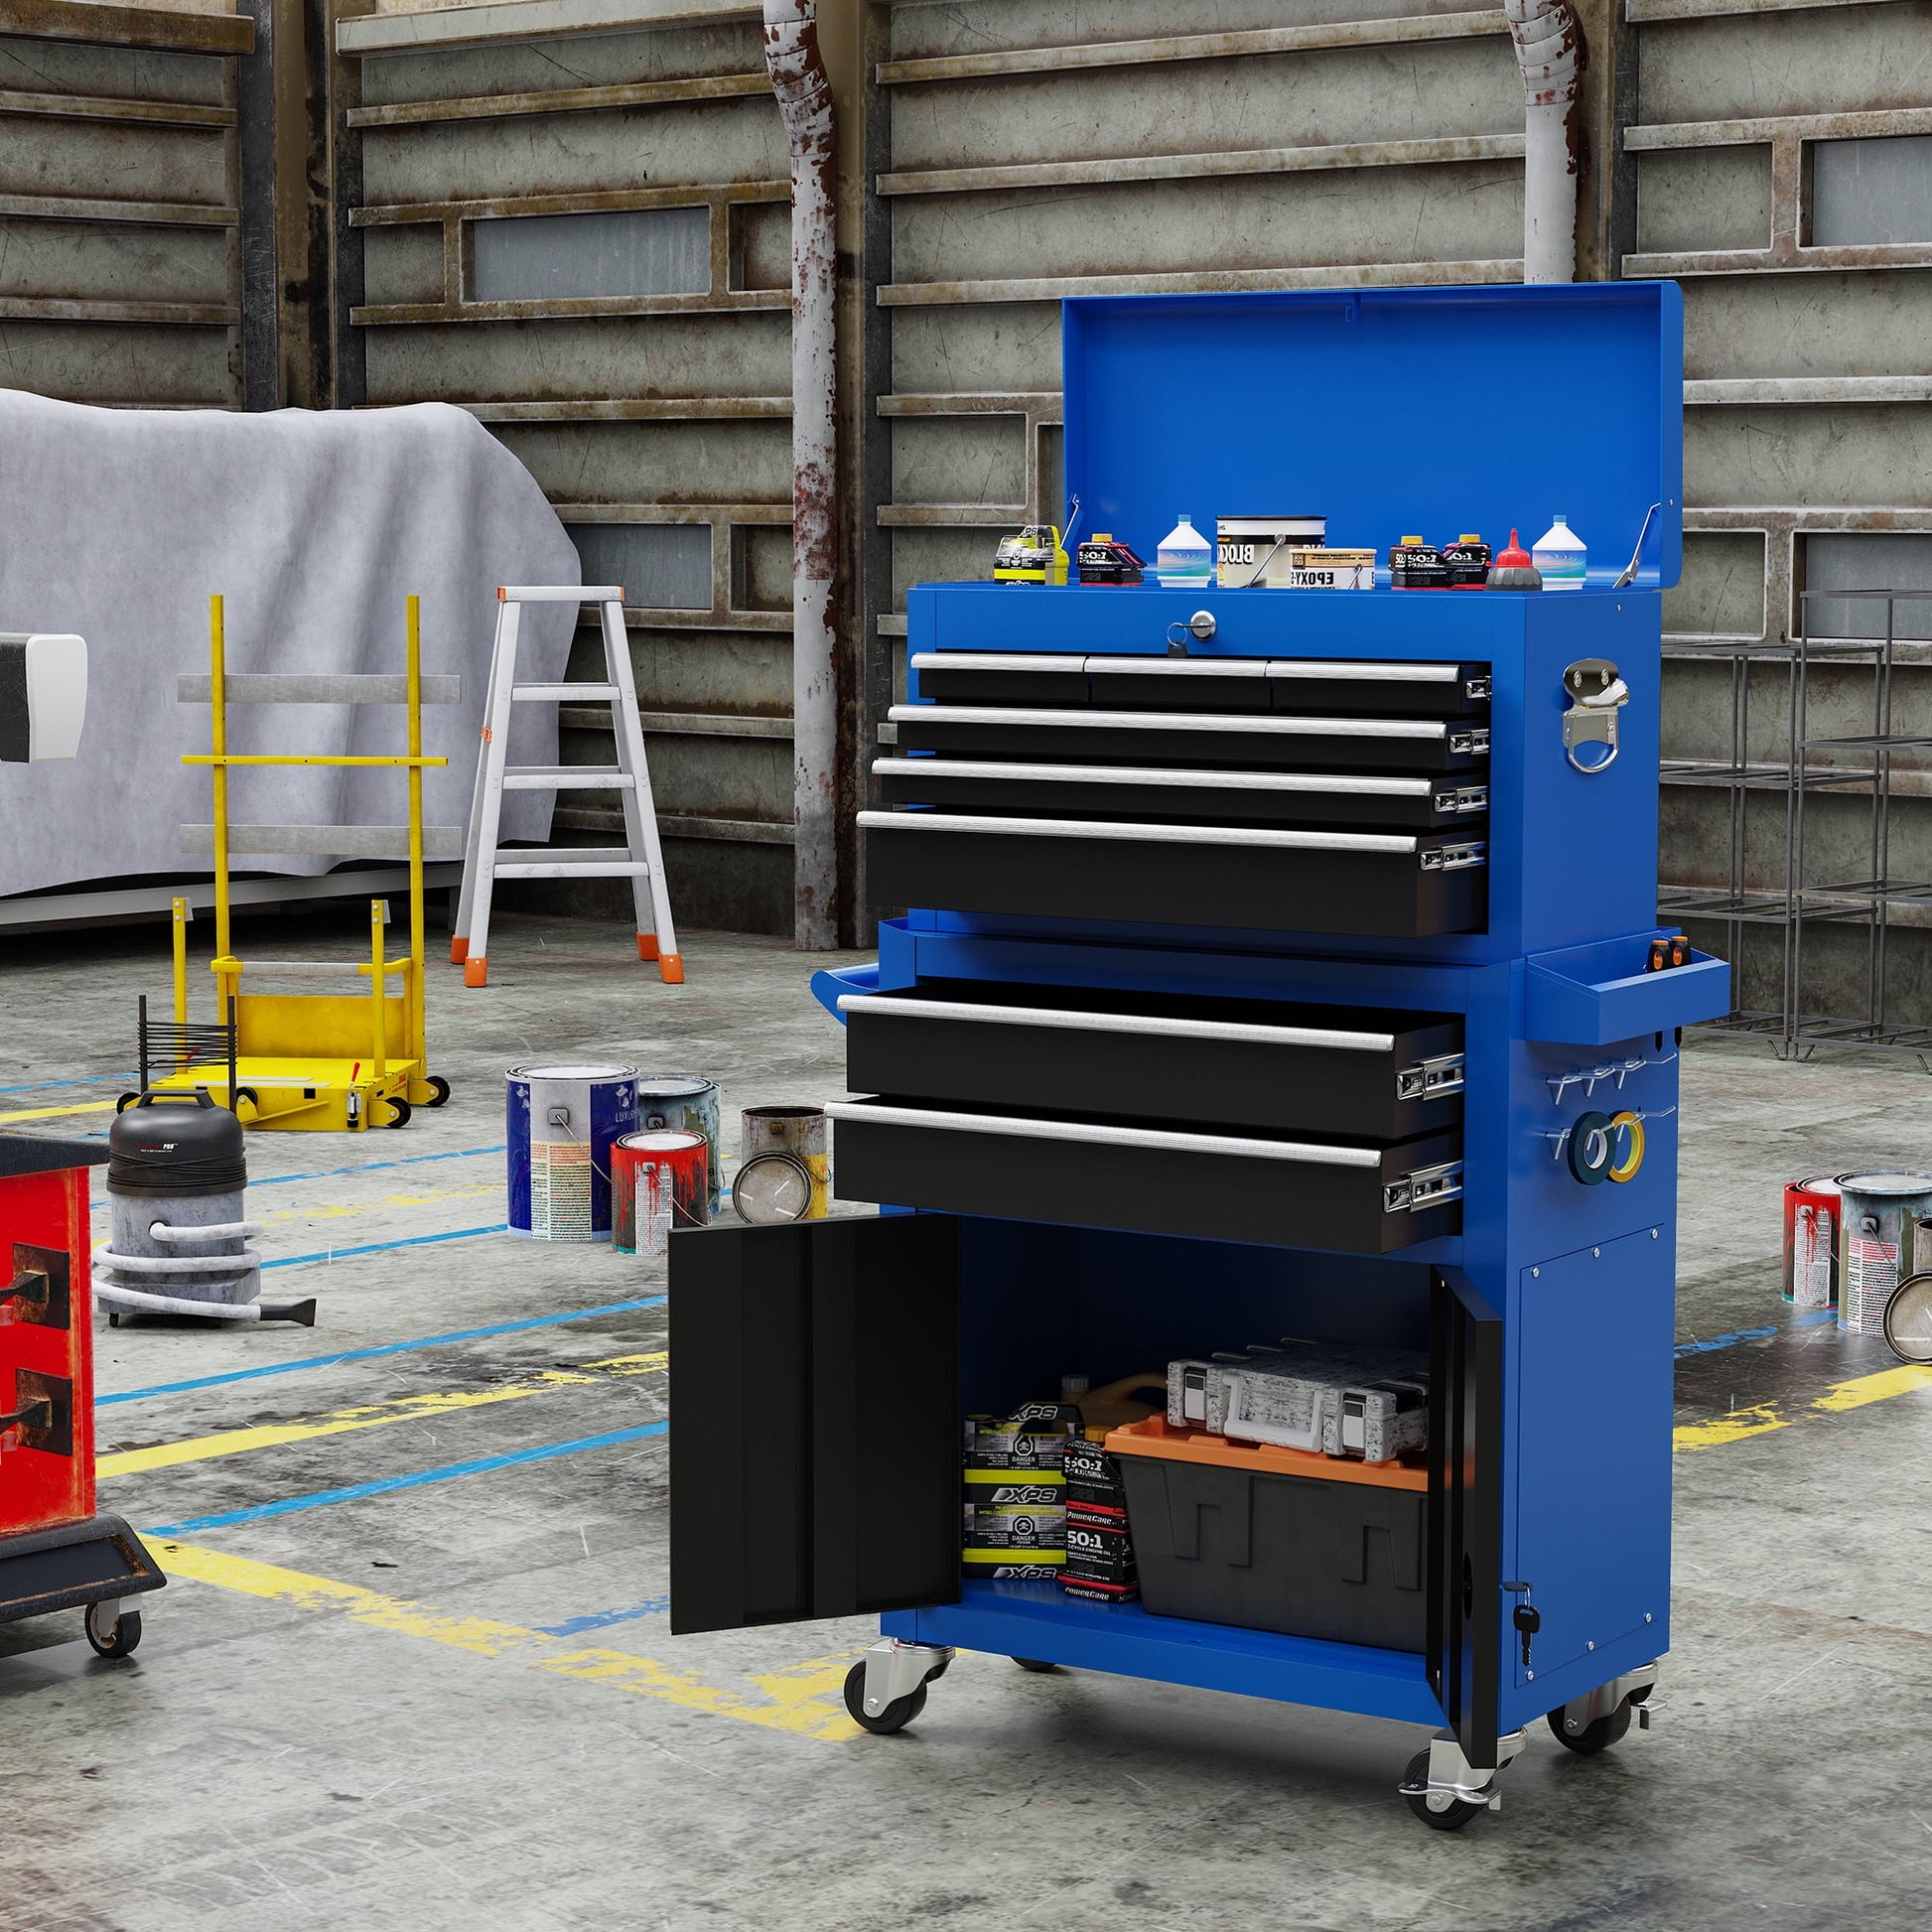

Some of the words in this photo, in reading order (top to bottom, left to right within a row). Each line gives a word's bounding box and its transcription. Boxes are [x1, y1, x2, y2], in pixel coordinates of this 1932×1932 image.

[1447, 552, 1473, 561] 0:1
[1003, 1485, 1057, 1503] XPS
[1067, 1530, 1103, 1549] 50:1
